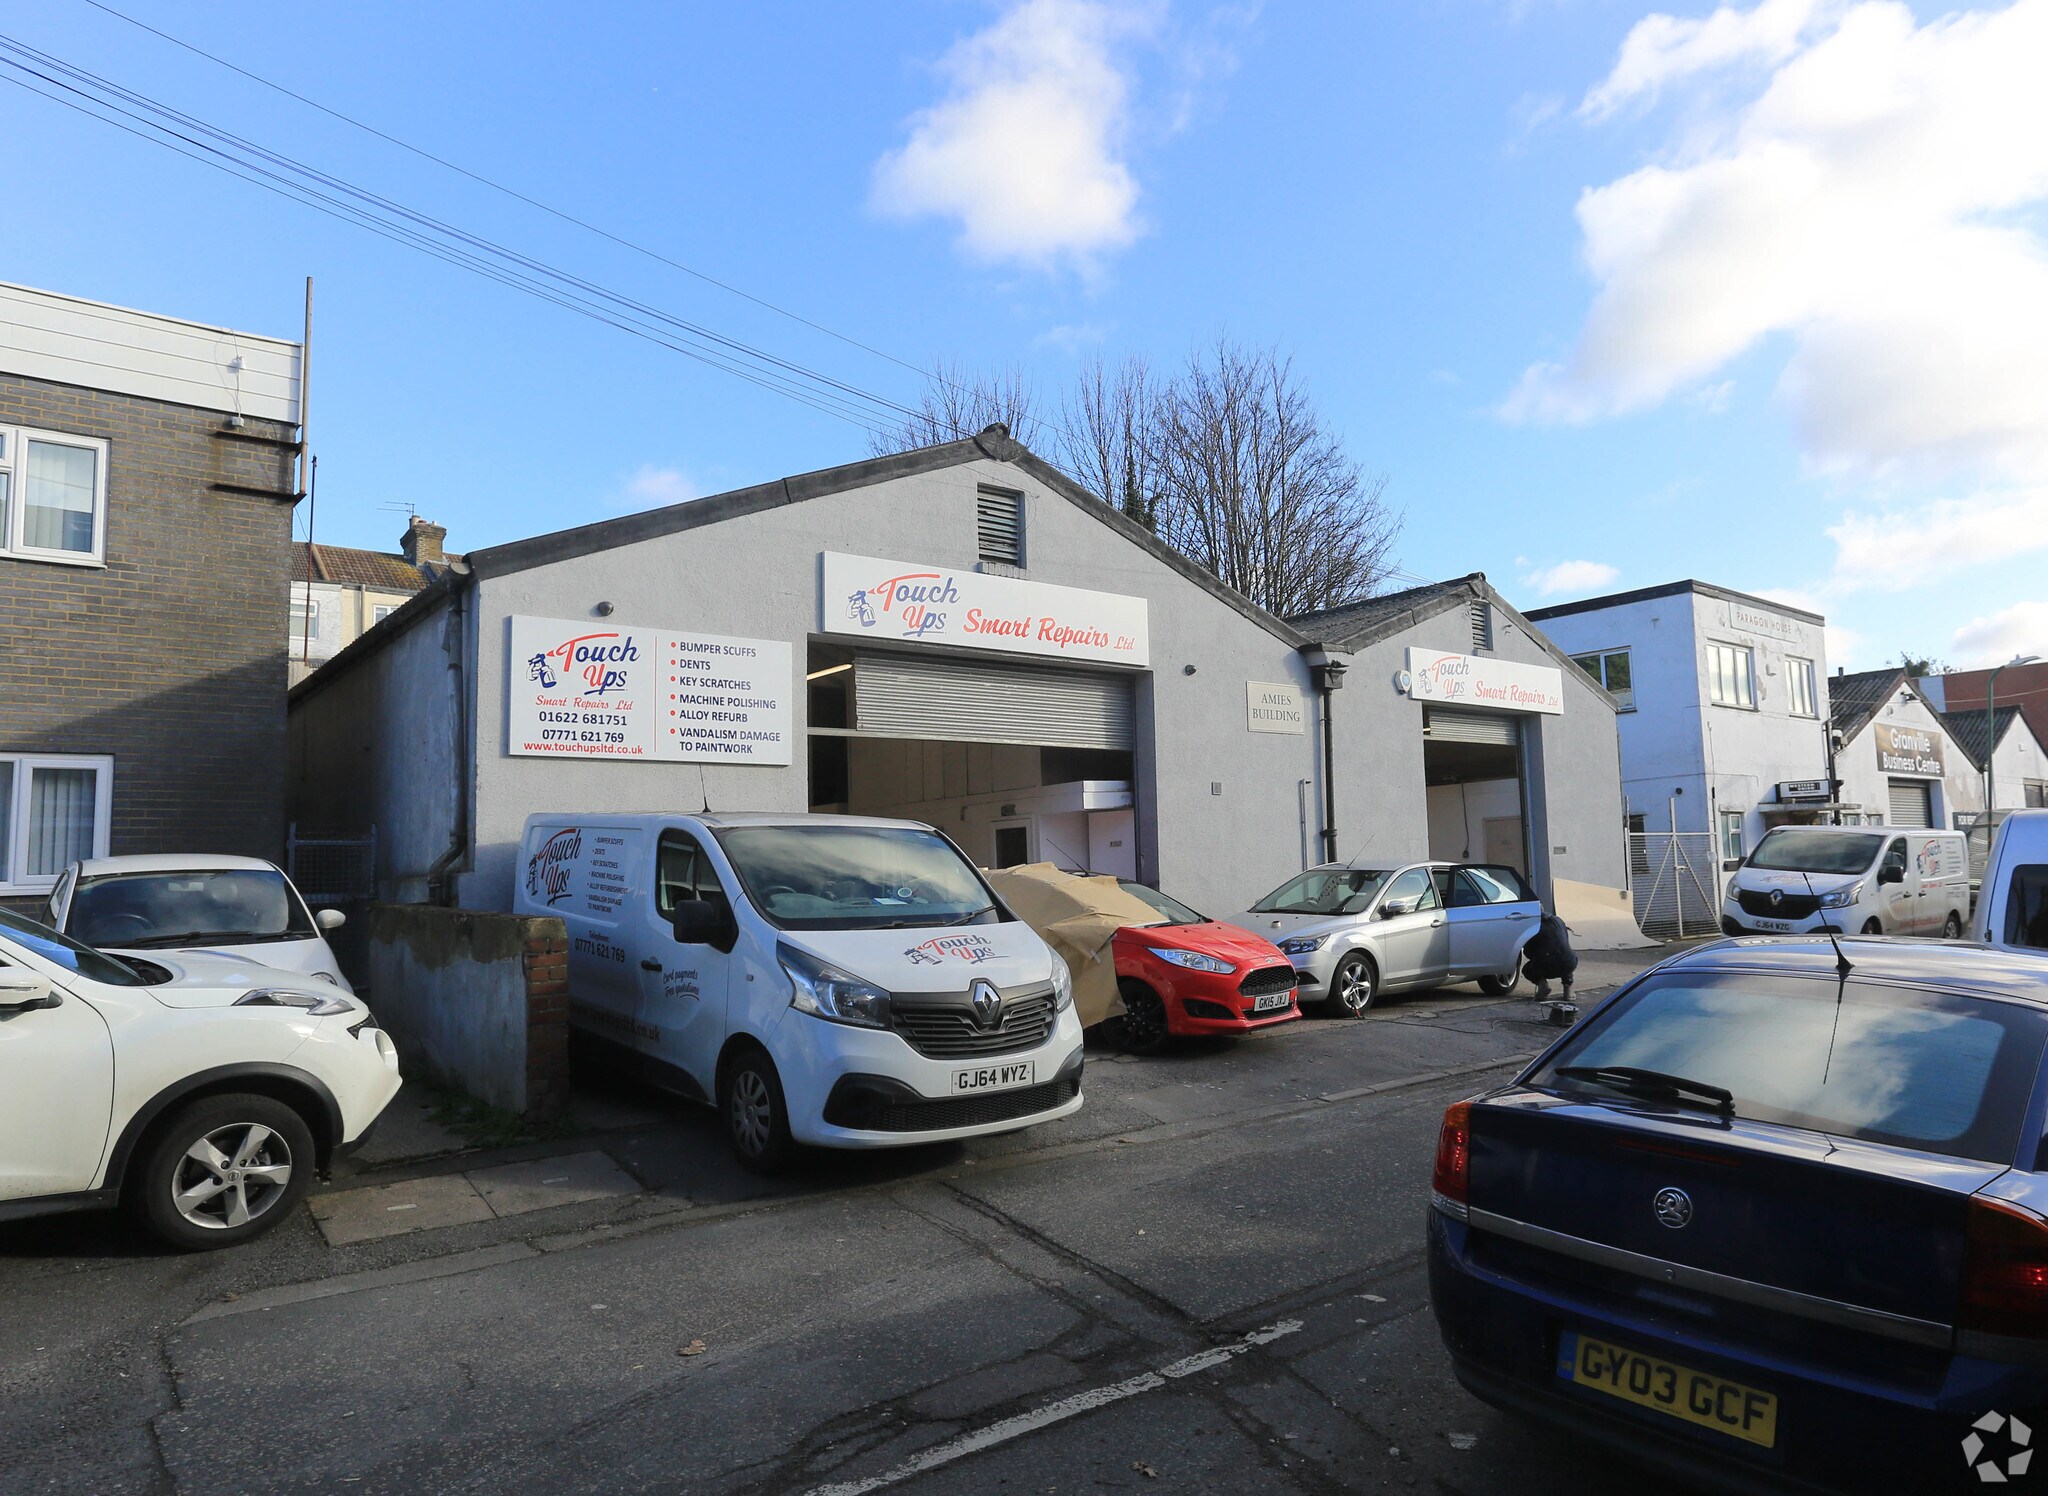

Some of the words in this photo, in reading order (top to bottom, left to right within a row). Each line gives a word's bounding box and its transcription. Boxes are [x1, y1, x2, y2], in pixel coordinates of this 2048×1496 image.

[877, 573, 961, 611] Touch
[902, 605, 947, 637] Ups
[963, 608, 1031, 638] Smart
[1037, 617, 1110, 648] Repairs
[1114, 636, 1135, 651] Ltd
[1737, 612, 1769, 628] PARAGON
[1772, 621, 1792, 634] HOUSE
[553, 633, 641, 672] Touch
[679, 641, 721, 655] BUMPER
[723, 644, 757, 657] SCUFFS
[679, 659, 711, 671] DENTS
[1431, 656, 1470, 683] Touch
[583, 664, 627, 695] Ups
[679, 676, 698, 688] KEY
[700, 678, 751, 691] SCRATCHES
[1443, 678, 1465, 699] Ups
[535, 695, 567, 707] Smart
[573, 697, 609, 711] Repairs
[615, 699, 633, 711] Ltd
[679, 694, 725, 707] MACHINE
[727, 697, 777, 710] POLISHING
[1261, 692, 1292, 707] AMIES
[1475, 680, 1507, 700] Smart
[1510, 684, 1545, 706] Repairs
[539, 711, 578, 724] 01622
[582, 712, 627, 726] 681751
[679, 709, 709, 722] ALLOY
[711, 711, 748, 723] REFURB
[1252, 707, 1301, 723] BUILDING
[542, 729, 577, 743] 07771
[580, 730, 601, 743] 621
[604, 731, 624, 743] 769
[679, 727, 737, 740] VANDALISM
[739, 730, 781, 742] DAMAGE
[1890, 728, 1931, 752] Granville
[523, 740, 643, 755] www.touchupsltd.co.uk
[679, 741, 692, 751] TO
[695, 741, 753, 754] PAINTWORK
[1883, 751, 1915, 771] Business
[1916, 755, 1941, 774] Centre
[540, 828, 582, 879] Touch
[545, 865, 572, 905] Ups
[1756, 921, 1774, 930] GJ64
[1776, 923, 1790, 931] WZG
[575, 938, 595, 956] 07771
[597, 942, 610, 959] 621
[611, 946, 625, 963] 769
[921, 935, 991, 956] Touch
[951, 946, 997, 965] Ups
[1259, 996, 1274, 1009] GK15
[958, 1071, 997, 1090] GJ64
[1001, 1064, 1027, 1084] WYZ
[1582, 1342, 1677, 1405] GY03
[1689, 1376, 1770, 1430] GCF
